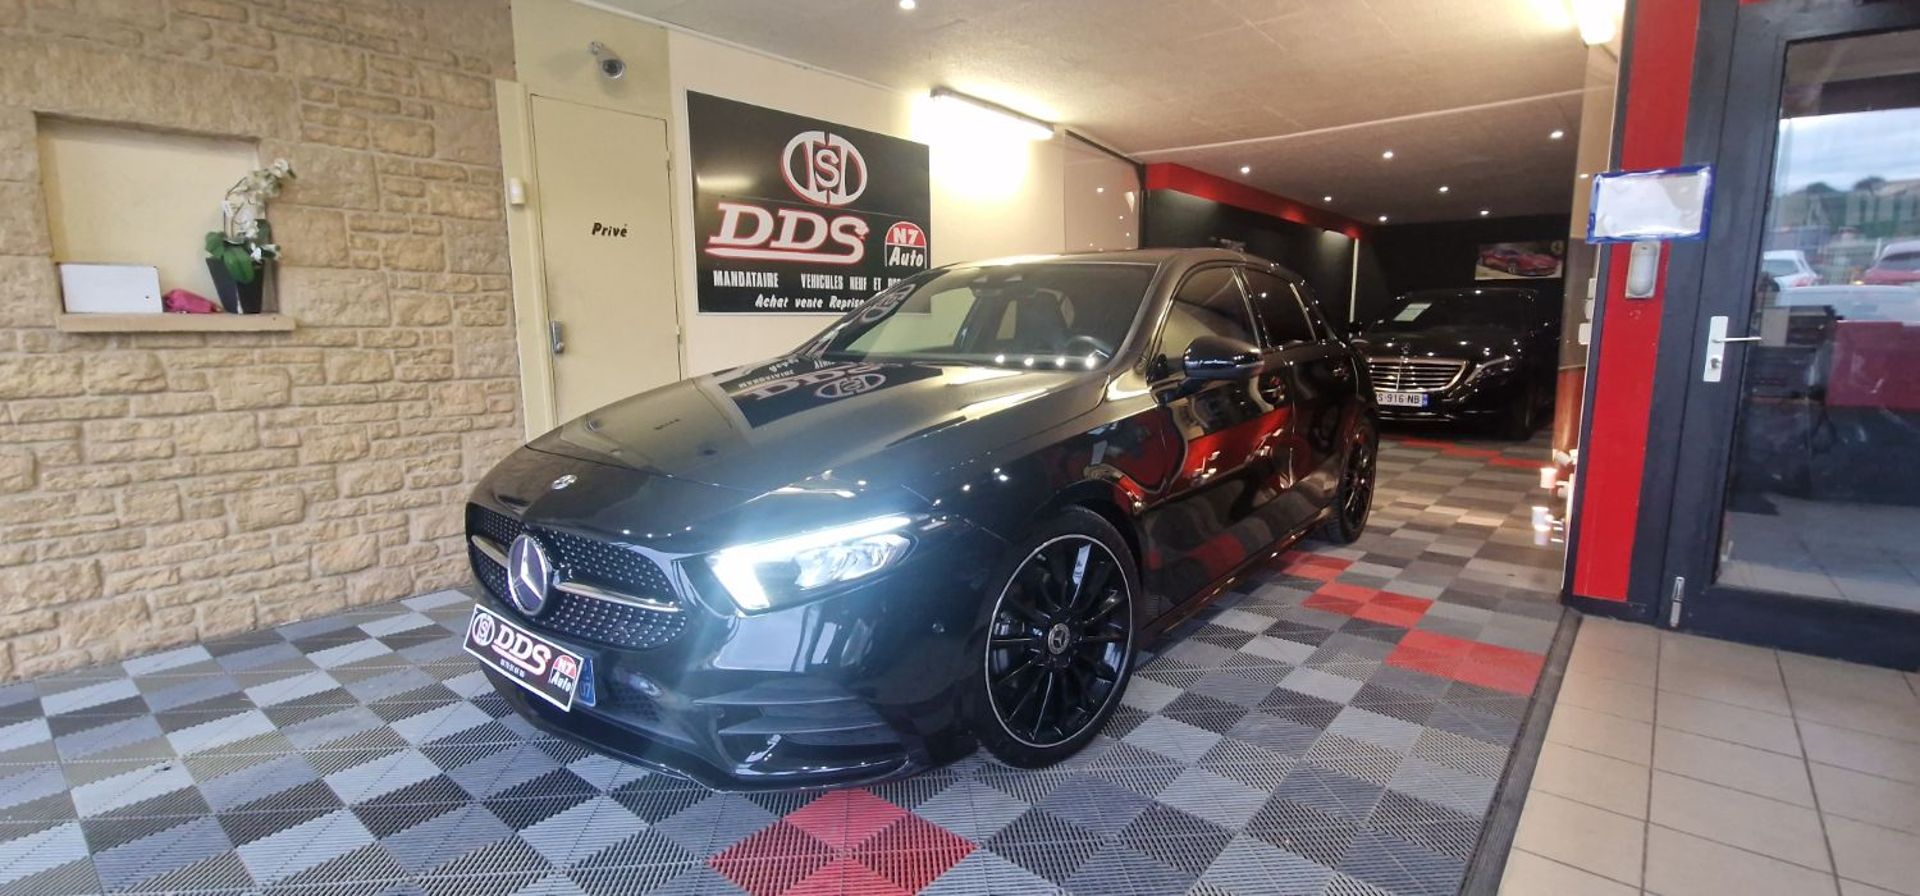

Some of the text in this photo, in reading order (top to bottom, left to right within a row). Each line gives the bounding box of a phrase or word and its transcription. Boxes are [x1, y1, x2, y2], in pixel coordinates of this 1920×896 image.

[591, 222, 628, 238] Privé
[704, 203, 869, 264] DDS
[892, 226, 918, 245] N7
[888, 245, 924, 268] Auto
[713, 270, 779, 288] MANDATAIRE
[800, 273, 844, 290] VEHICULES
[849, 276, 867, 291] NEUF
[873, 277, 882, 290] ET
[754, 293, 789, 308] Achat
[794, 297, 823, 308] vente
[491, 624, 552, 676] DDS
[558, 658, 573, 673] N7
[551, 672, 571, 692] Auto
